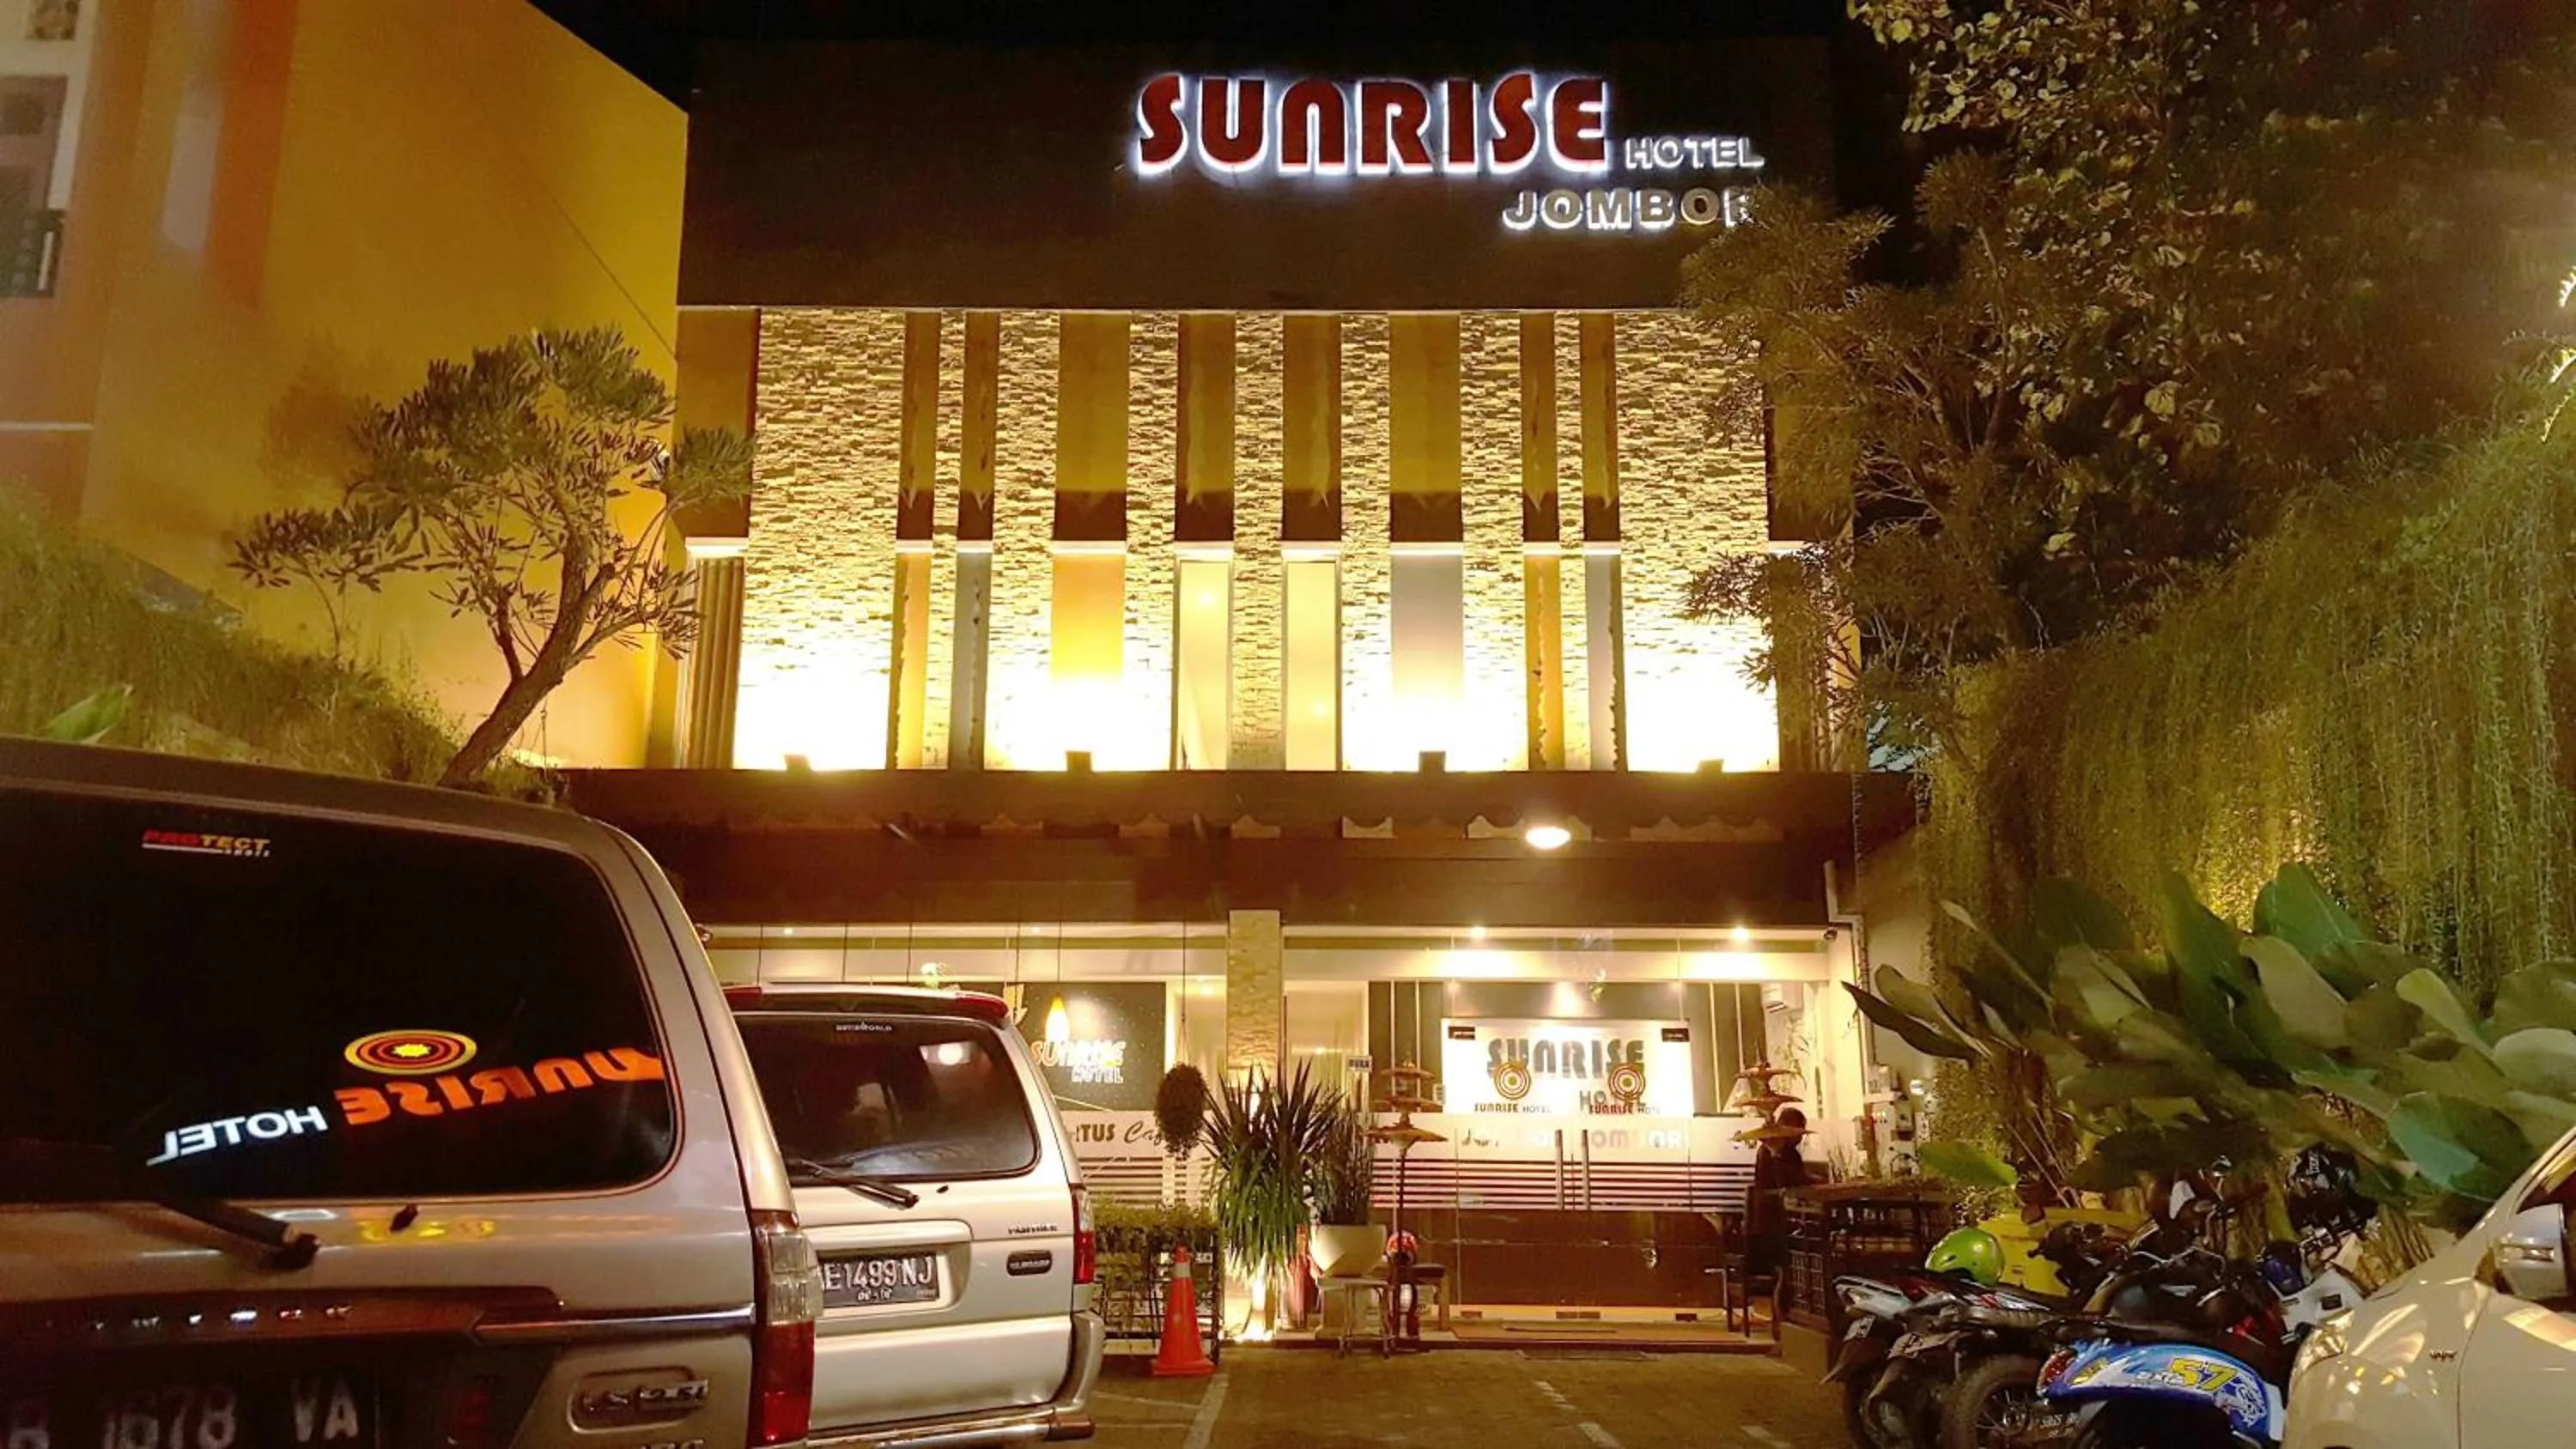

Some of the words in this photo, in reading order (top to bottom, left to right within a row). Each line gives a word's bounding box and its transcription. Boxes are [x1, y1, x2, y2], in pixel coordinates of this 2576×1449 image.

[1137, 71, 1608, 173] SUNRISE
[1625, 136, 1765, 169] HOTEL
[1473, 1102, 1519, 1113] SUNRISE
[844, 1259, 897, 1288] 1499
[902, 1255, 933, 1286] NJ
[289, 1375, 360, 1443] VA
